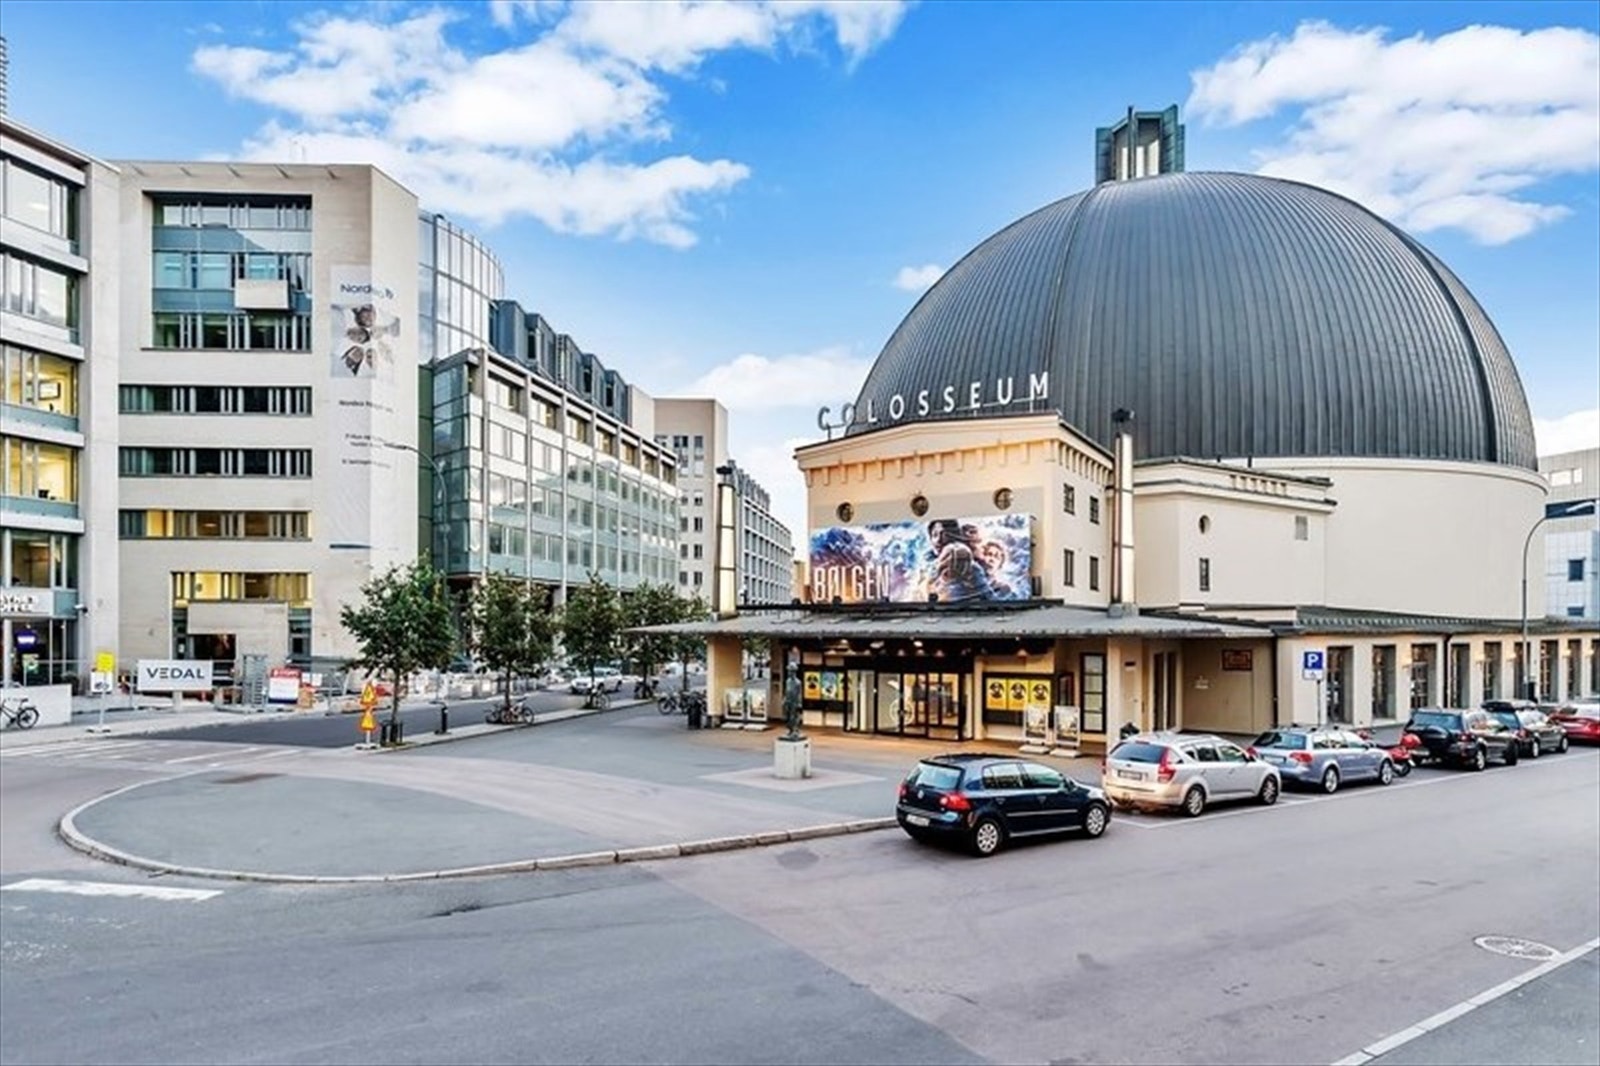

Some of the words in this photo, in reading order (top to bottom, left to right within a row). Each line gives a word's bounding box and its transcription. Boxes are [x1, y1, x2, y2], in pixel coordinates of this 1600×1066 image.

[817, 371, 1049, 430] COLOSSEUM
[814, 564, 890, 602] BØLGEN
[146, 667, 205, 679] VEDAL
[1307, 653, 1319, 668] P
